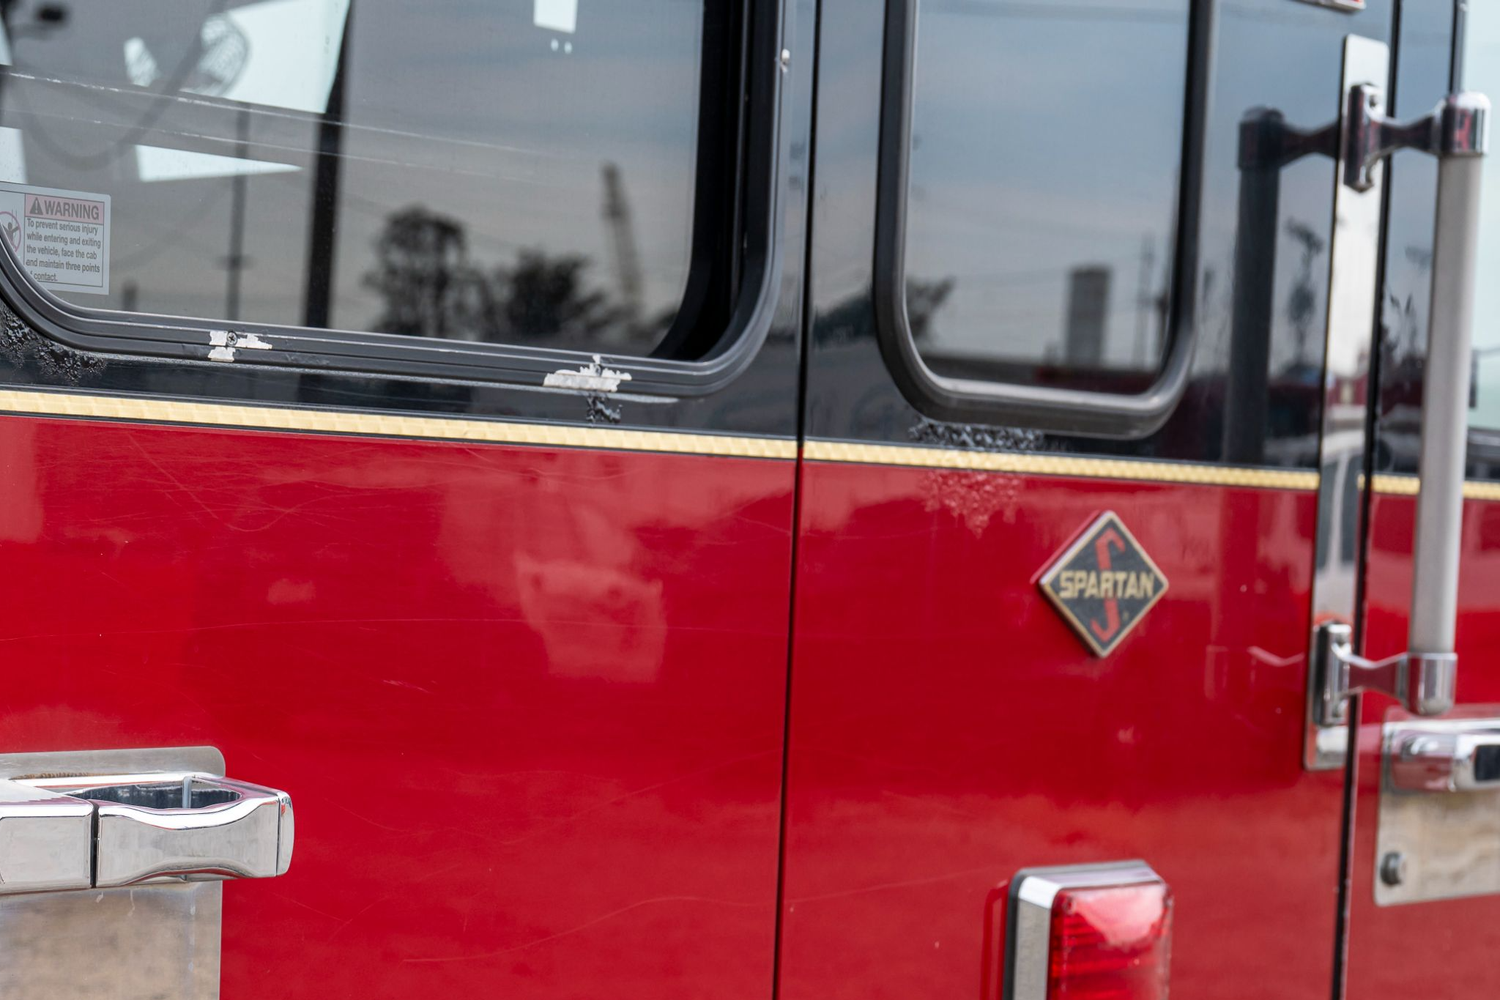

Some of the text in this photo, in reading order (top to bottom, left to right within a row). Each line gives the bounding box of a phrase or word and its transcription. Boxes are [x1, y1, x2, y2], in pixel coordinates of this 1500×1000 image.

[44, 200, 99, 220] WARNING
[27, 218, 98, 236] To prevent serious injury
[27, 232, 101, 249] while entering and exiting
[27, 244, 97, 260] the vehicle, face the cab
[26, 258, 100, 273] and maintain three points
[34, 273, 58, 282] contact.
[1058, 570, 1155, 599] SPARTAN
